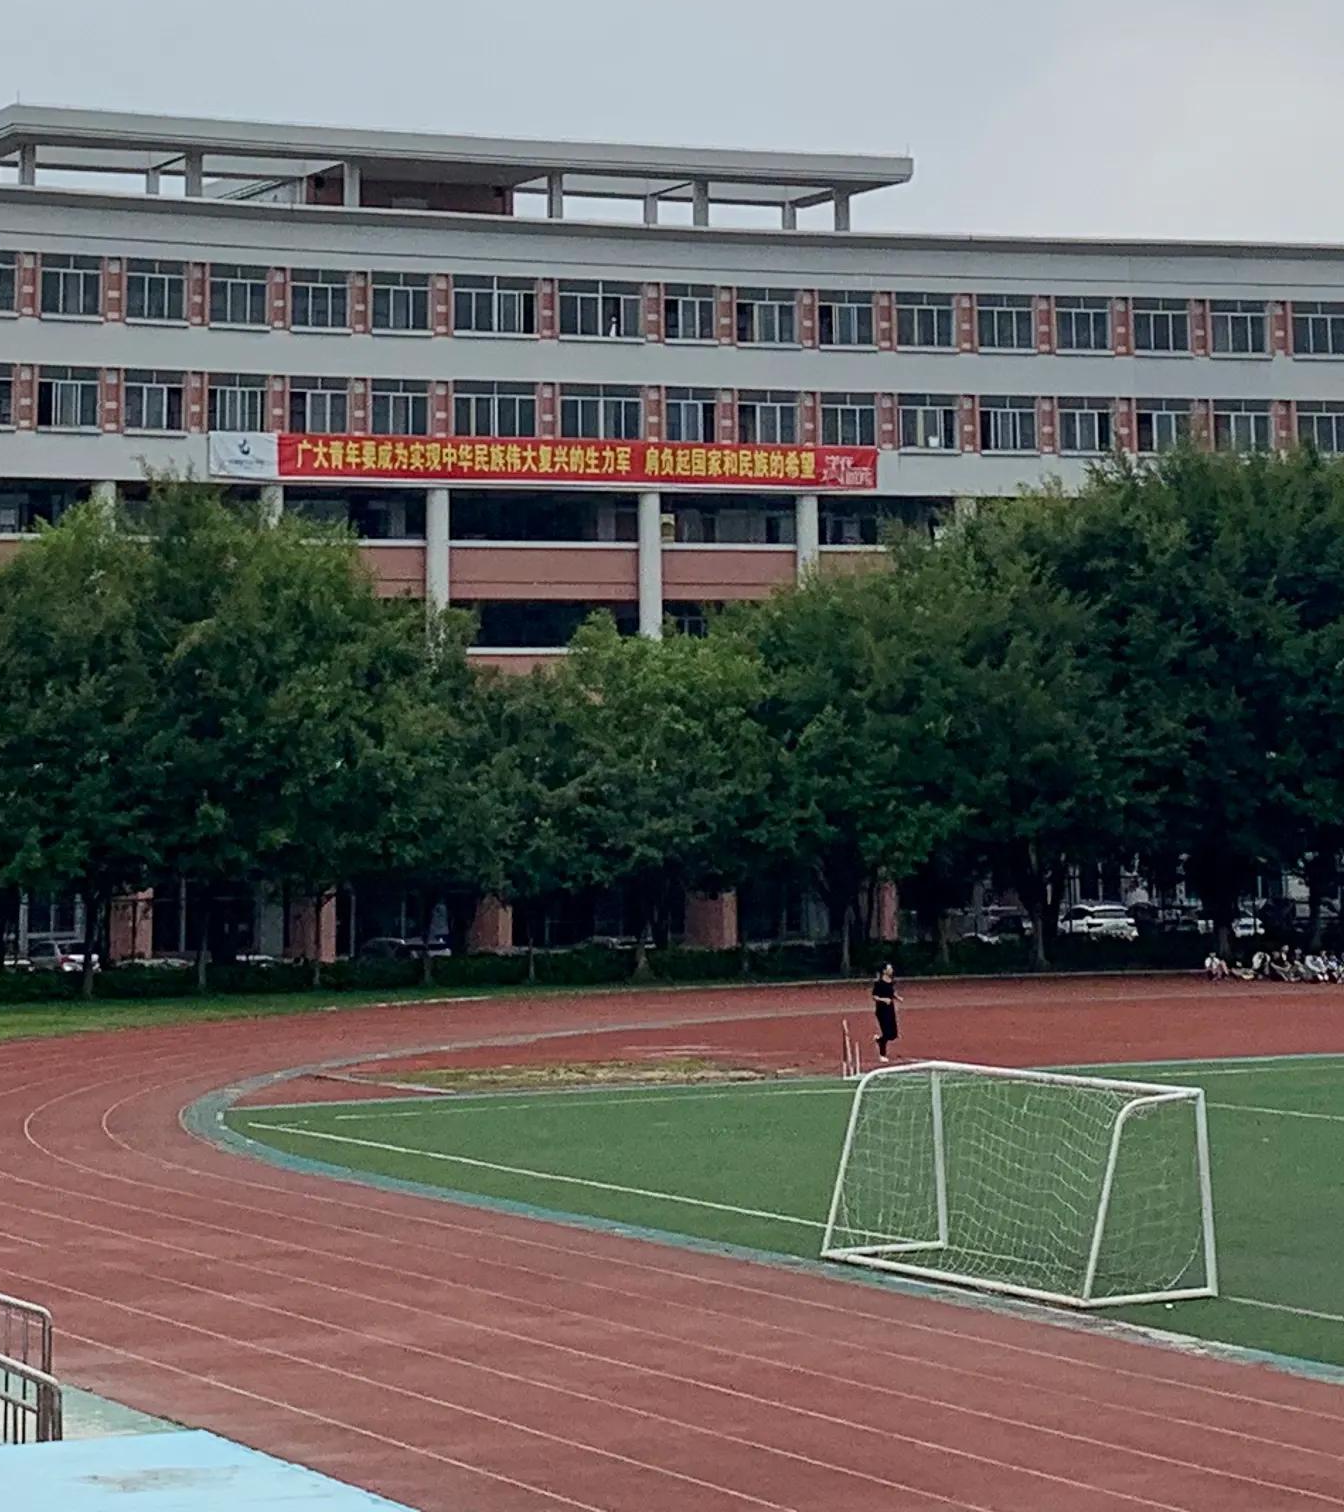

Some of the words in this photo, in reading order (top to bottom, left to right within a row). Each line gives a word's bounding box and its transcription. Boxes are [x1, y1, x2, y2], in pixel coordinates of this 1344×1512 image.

[297, 439, 632, 475] 广大青年要成为实现中华民族伟大复兴的生力军
[645, 446, 816, 479] 肩负起国家和民族的希望
